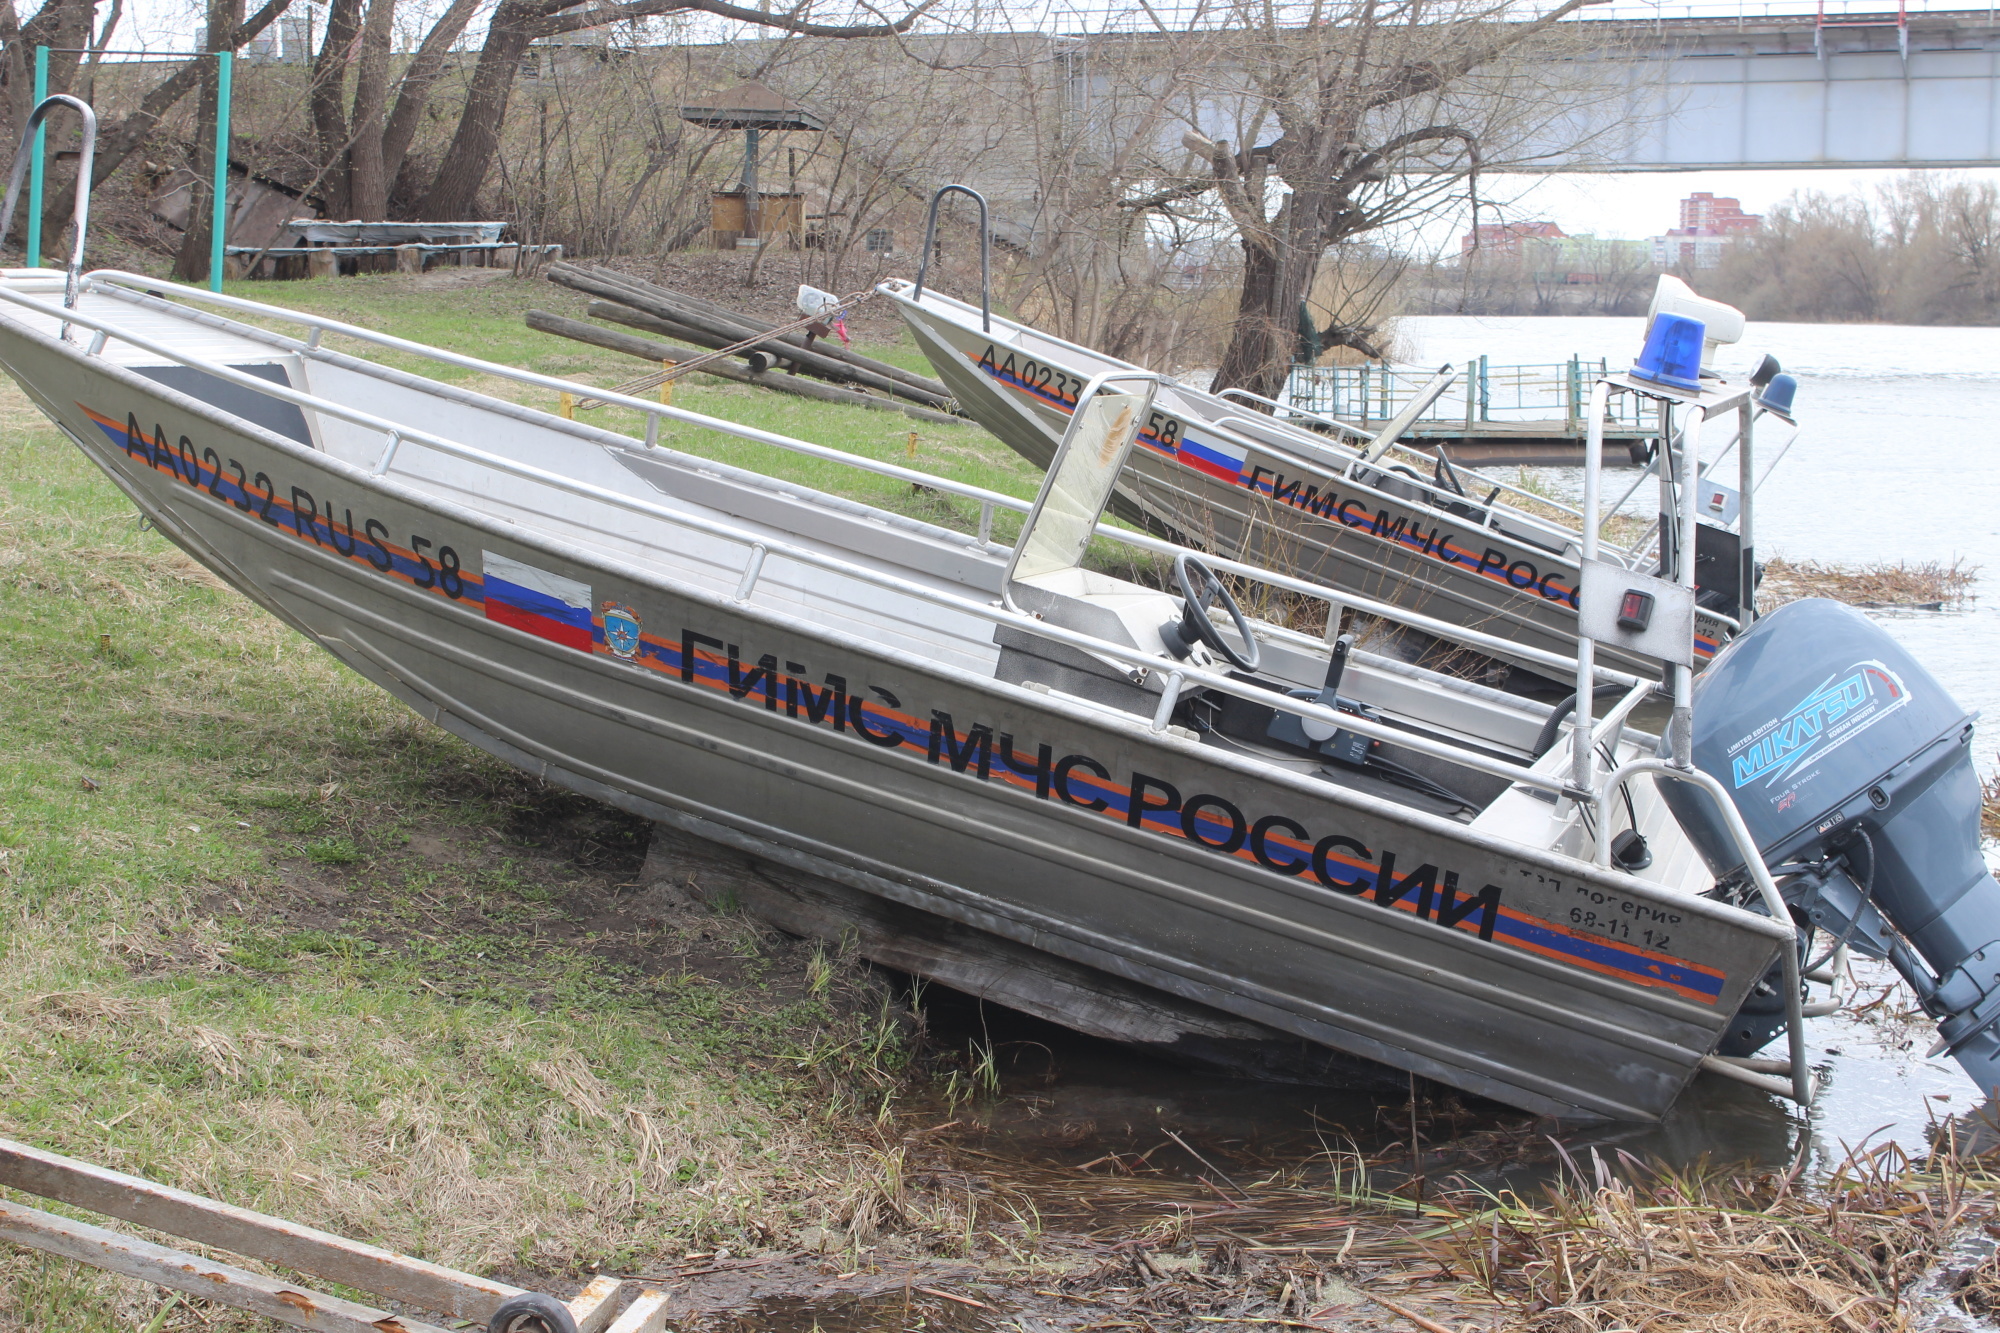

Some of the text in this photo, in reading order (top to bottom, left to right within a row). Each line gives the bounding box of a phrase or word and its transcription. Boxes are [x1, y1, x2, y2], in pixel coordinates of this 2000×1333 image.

[978, 345, 1178, 447] AA0233 58
[126, 411, 464, 600] AA0232 RUS 58
[1248, 465, 1367, 528] ГИМС
[1369, 509, 1462, 563] МЧС
[1726, 717, 1778, 754] LIMITED EDITION
[1827, 721, 1851, 740] KOREAN
[1850, 704, 1877, 729] INDUSTRY
[681, 628, 1503, 943] ГИМС МЧС РОССИИ
